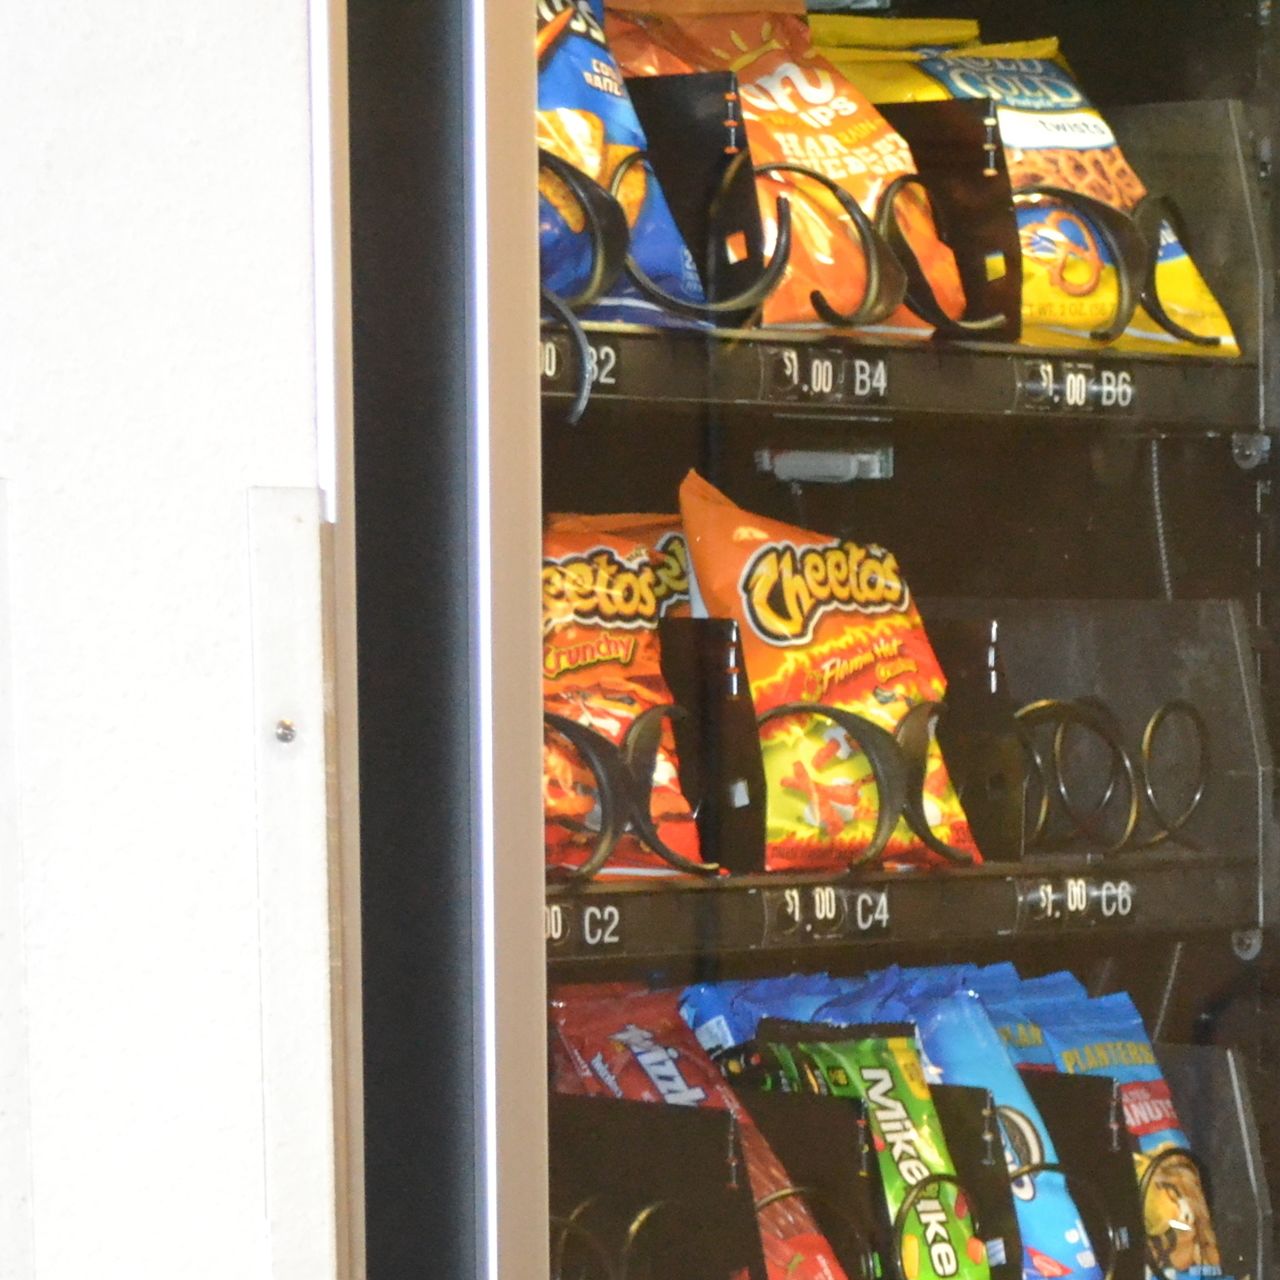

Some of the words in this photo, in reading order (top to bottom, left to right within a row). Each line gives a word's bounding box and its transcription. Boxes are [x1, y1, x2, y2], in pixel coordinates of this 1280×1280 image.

[783, 349, 833, 393] $1.00
[854, 359, 888, 397] B4
[1040, 363, 1087, 406] $1.00
[1101, 370, 1132, 407] B6
[541, 553, 656, 617] eetos
[748, 541, 903, 637] Cheetos
[784, 886, 836, 932] $1.00
[857, 892, 889, 930] C4
[1039, 879, 1087, 918] $1.00
[1101, 881, 1132, 917] C6
[584, 905, 620, 945] C2
[861, 1066, 930, 1188] Mike
